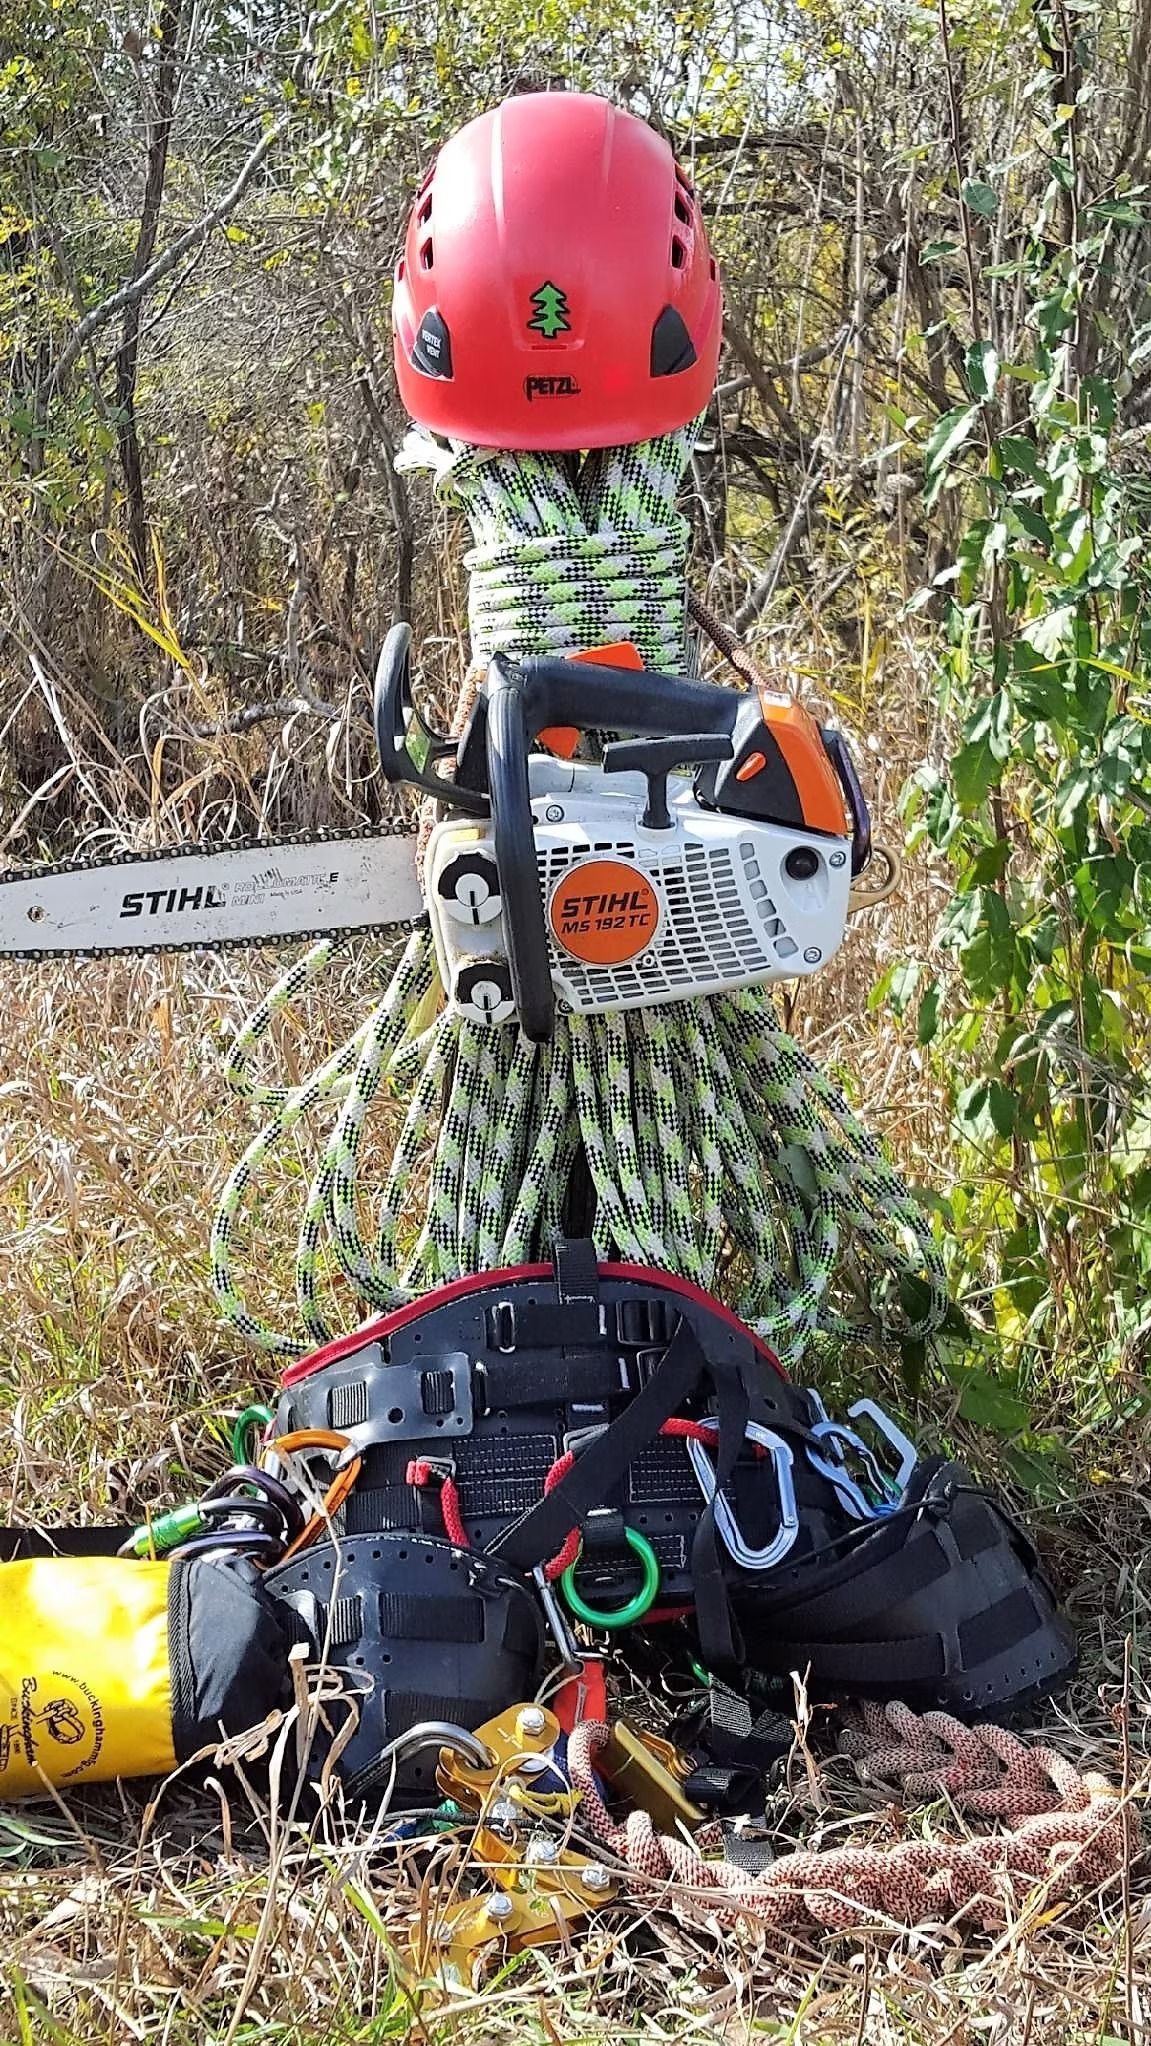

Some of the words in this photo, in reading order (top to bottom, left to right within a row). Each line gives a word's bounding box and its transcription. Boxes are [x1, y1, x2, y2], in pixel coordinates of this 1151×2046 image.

[421, 329, 442, 349] VERTEX
[426, 344, 441, 359] VENT
[526, 376, 582, 402] PETZL
[119, 885, 227, 918] STIHL
[231, 892, 266, 907] MINI
[561, 891, 649, 918] STIHL
[562, 920, 591, 934] MS
[594, 916, 626, 931] 192
[629, 913, 652, 928] TC
